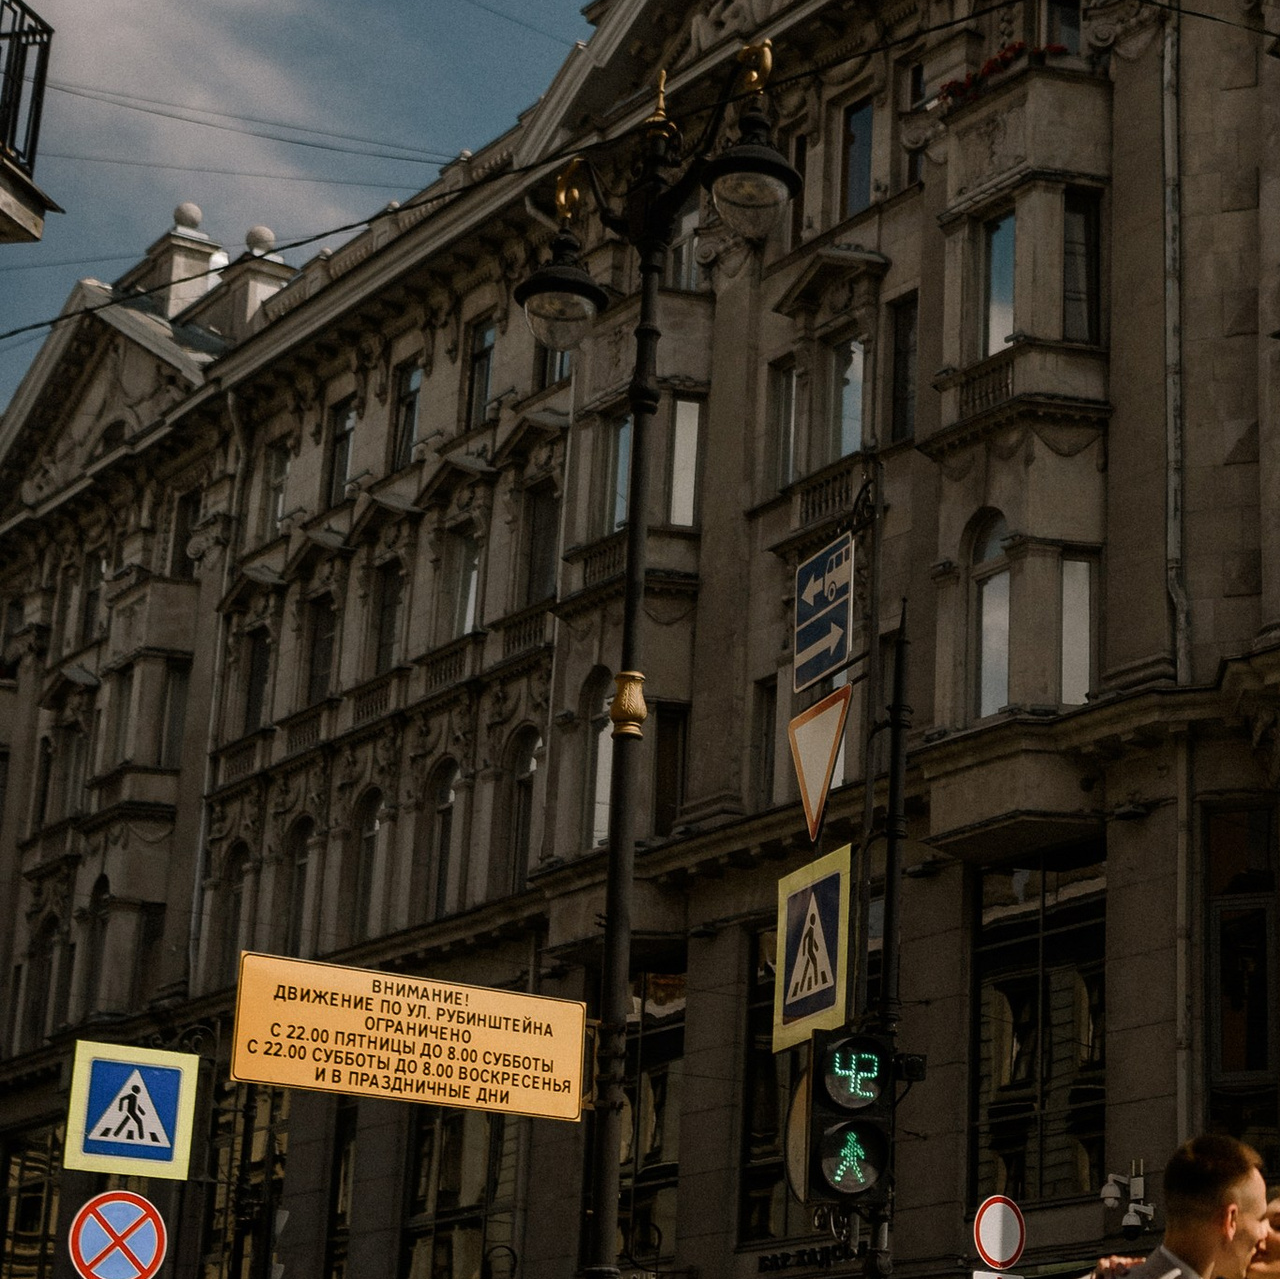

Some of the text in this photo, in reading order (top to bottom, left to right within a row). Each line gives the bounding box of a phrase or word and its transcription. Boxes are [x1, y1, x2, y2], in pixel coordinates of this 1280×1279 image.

[274, 984, 553, 1037] ДВИЖЕНИЕ ПО УЛ. РУБИНШТЕЙНА
[372, 980, 469, 1006] ВНИМАНИЕ!
[271, 1023, 554, 1073] С 22.00 ПЯТНИЦЫ ДО 8.00 СУББОТЫ
[365, 1017, 471, 1043] ОГРАНИЧЕНО
[248, 1040, 571, 1093] С 22.00 СУББОТЫ ДО 8.00 ВОСКРЕСЕНЬЯ
[316, 1068, 509, 1104] И В ПРАЗДНИЧНЫЕ ДНИ
[834, 1052, 878, 1098] 42
